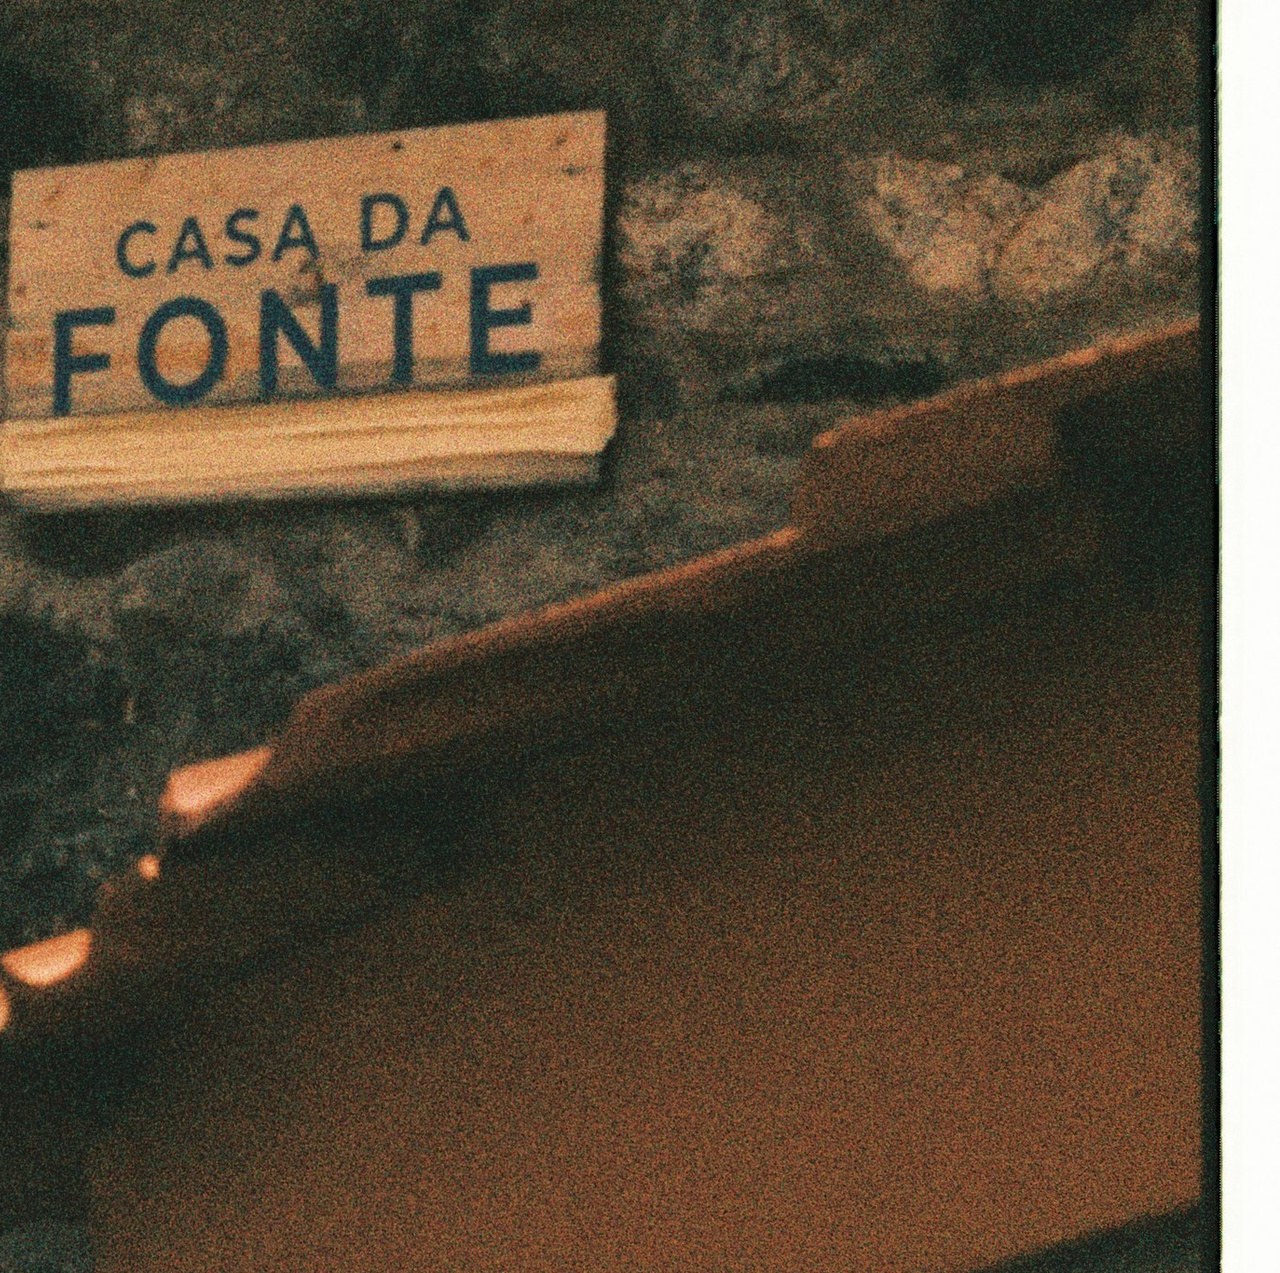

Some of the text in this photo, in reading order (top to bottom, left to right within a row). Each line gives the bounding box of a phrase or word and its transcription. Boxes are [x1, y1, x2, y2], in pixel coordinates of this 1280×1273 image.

[117, 186, 471, 278] CASA DA
[52, 262, 541, 417] FONTE
